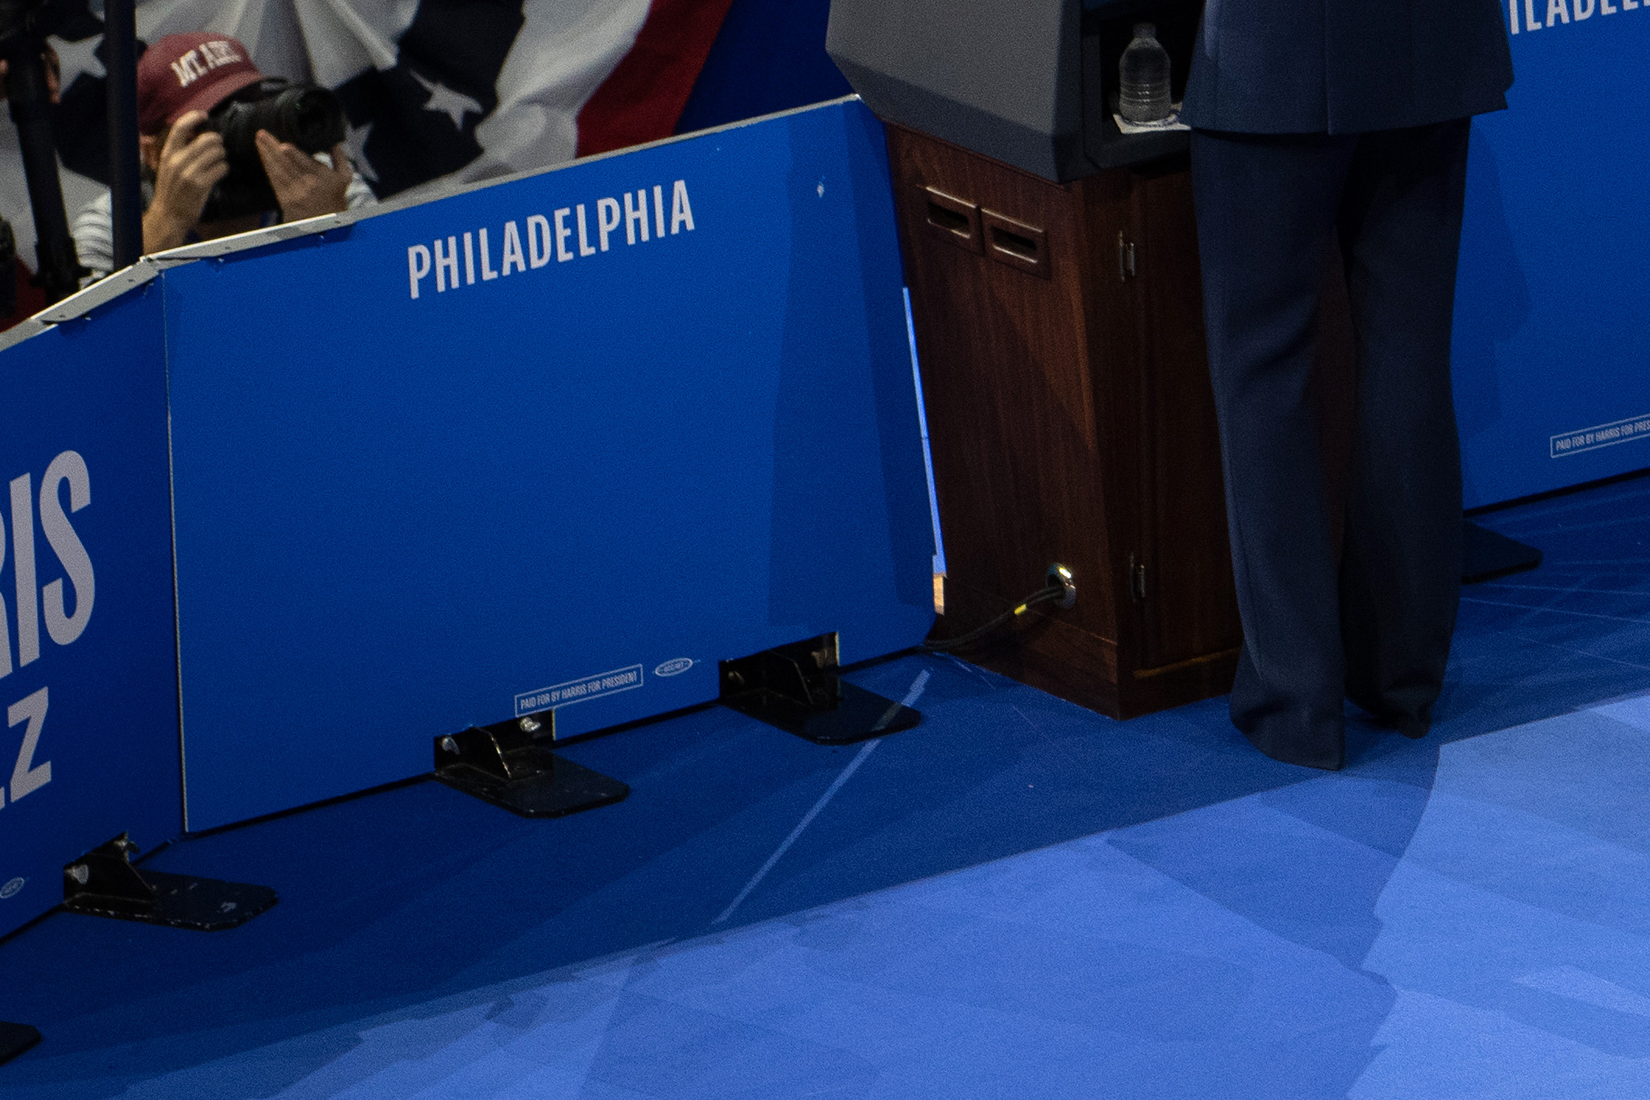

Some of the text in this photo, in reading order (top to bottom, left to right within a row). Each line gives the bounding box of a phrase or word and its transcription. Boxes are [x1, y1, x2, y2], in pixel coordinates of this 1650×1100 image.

[407, 179, 695, 300] PHILADELPHIA
[1555, 438, 1572, 451] PAID
[1572, 435, 1586, 448] FOR
[1585, 432, 1596, 444] BY
[1596, 426, 1621, 442] HARRIS
[1620, 422, 1634, 436] FOR
[520, 670, 638, 710] PAID FOR BY HARRIS FOR PRESIDENT
